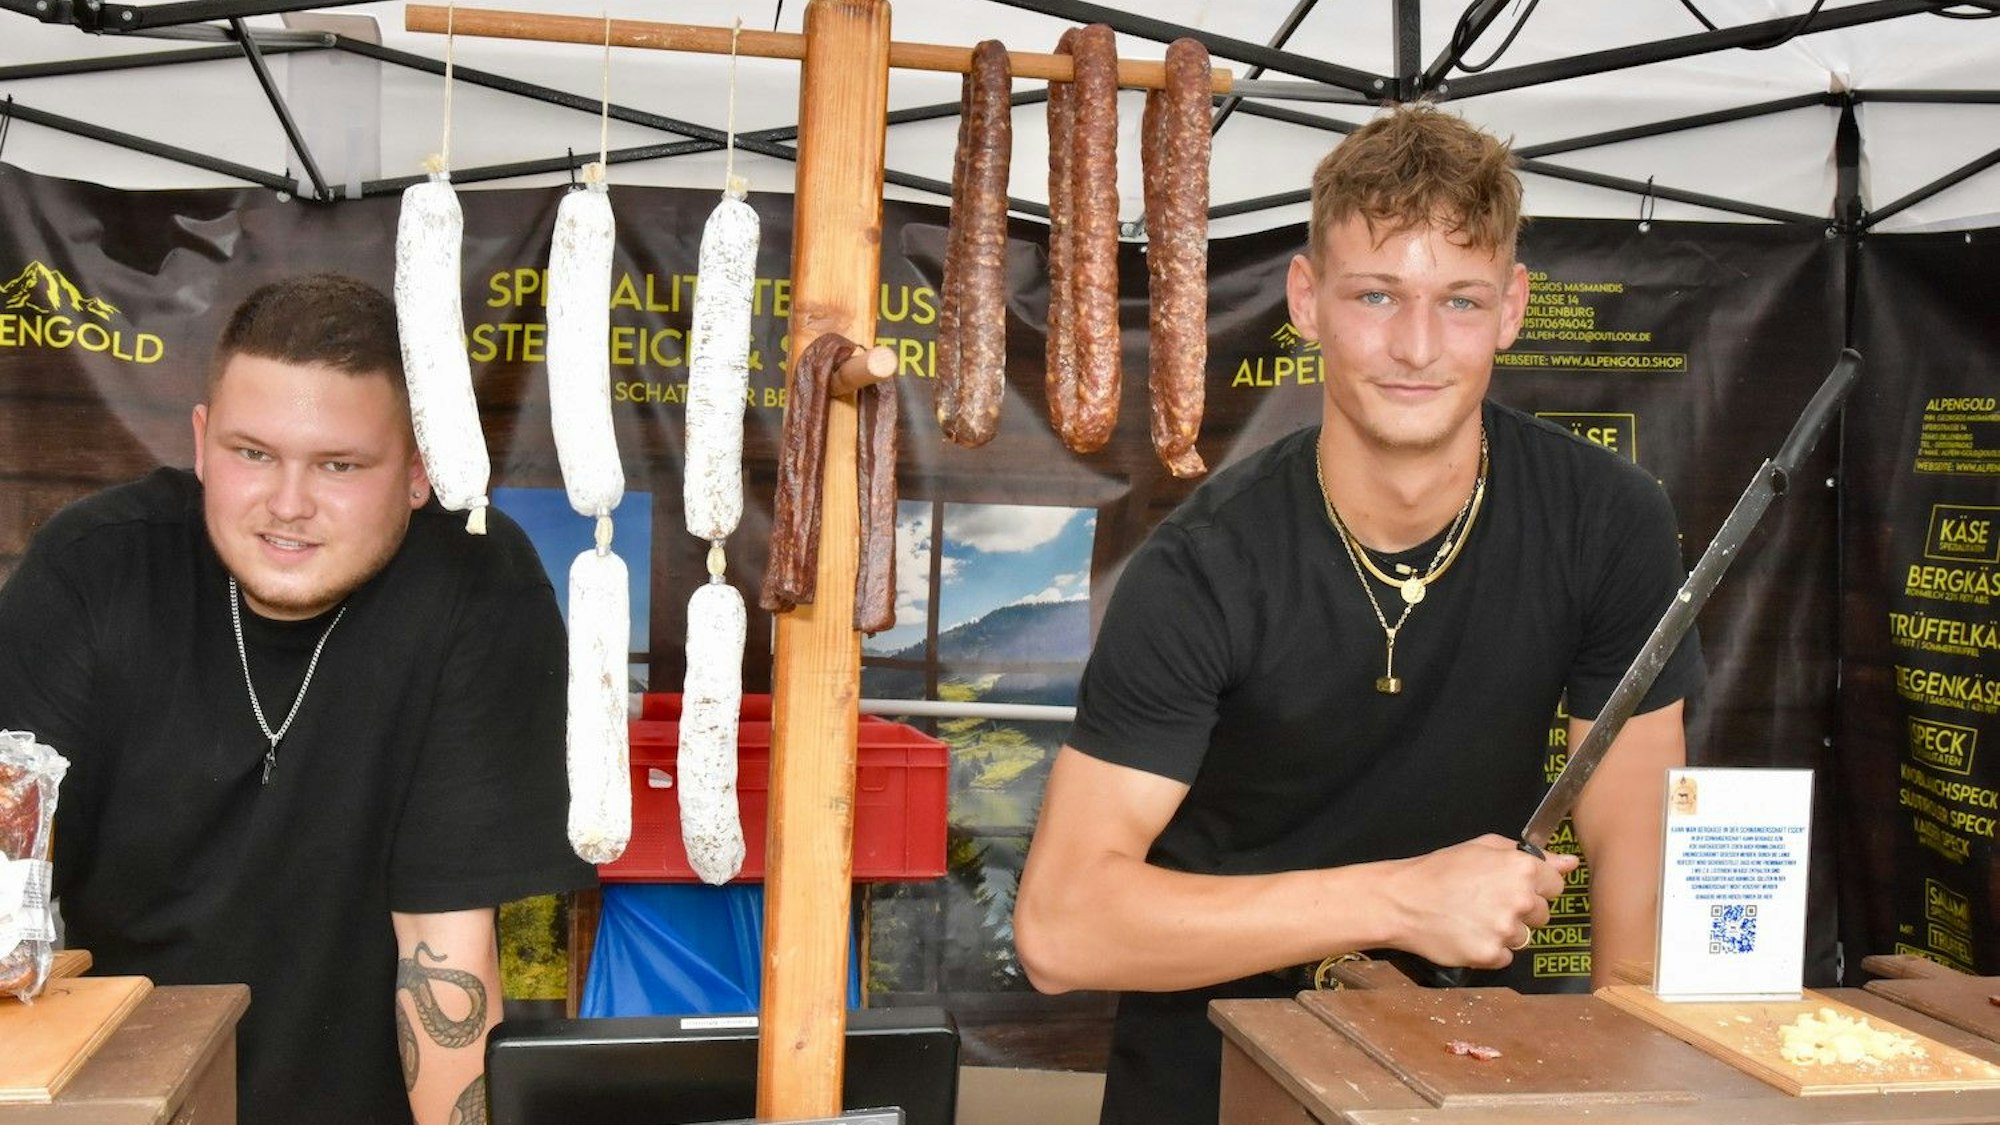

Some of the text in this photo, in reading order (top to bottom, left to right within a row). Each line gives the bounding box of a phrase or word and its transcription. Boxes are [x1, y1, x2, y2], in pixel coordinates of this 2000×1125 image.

[1530, 294, 1565, 304] RASSE
[1564, 283, 1624, 294] MASMANIDIS
[877, 284, 936, 324] US
[1526, 306, 1595, 317] DILLENBURG
[0, 314, 163, 363] ENGOLD
[1231, 356, 1324, 388] ALPE
[1495, 354, 1683, 369] WEBSEITE: WWW.ALPENGOLD.SHOP
[1926, 398, 1996, 411] ALPENGOLD
[1940, 515, 1991, 544] KÄSE
[1906, 565, 2000, 597] BERGKÄS
[1889, 611, 2000, 650] TRÜFFELKÄ
[1950, 810, 1996, 837] SPECK
[1528, 927, 1591, 945] KNOBL
[1536, 954, 1591, 974] PEPER
